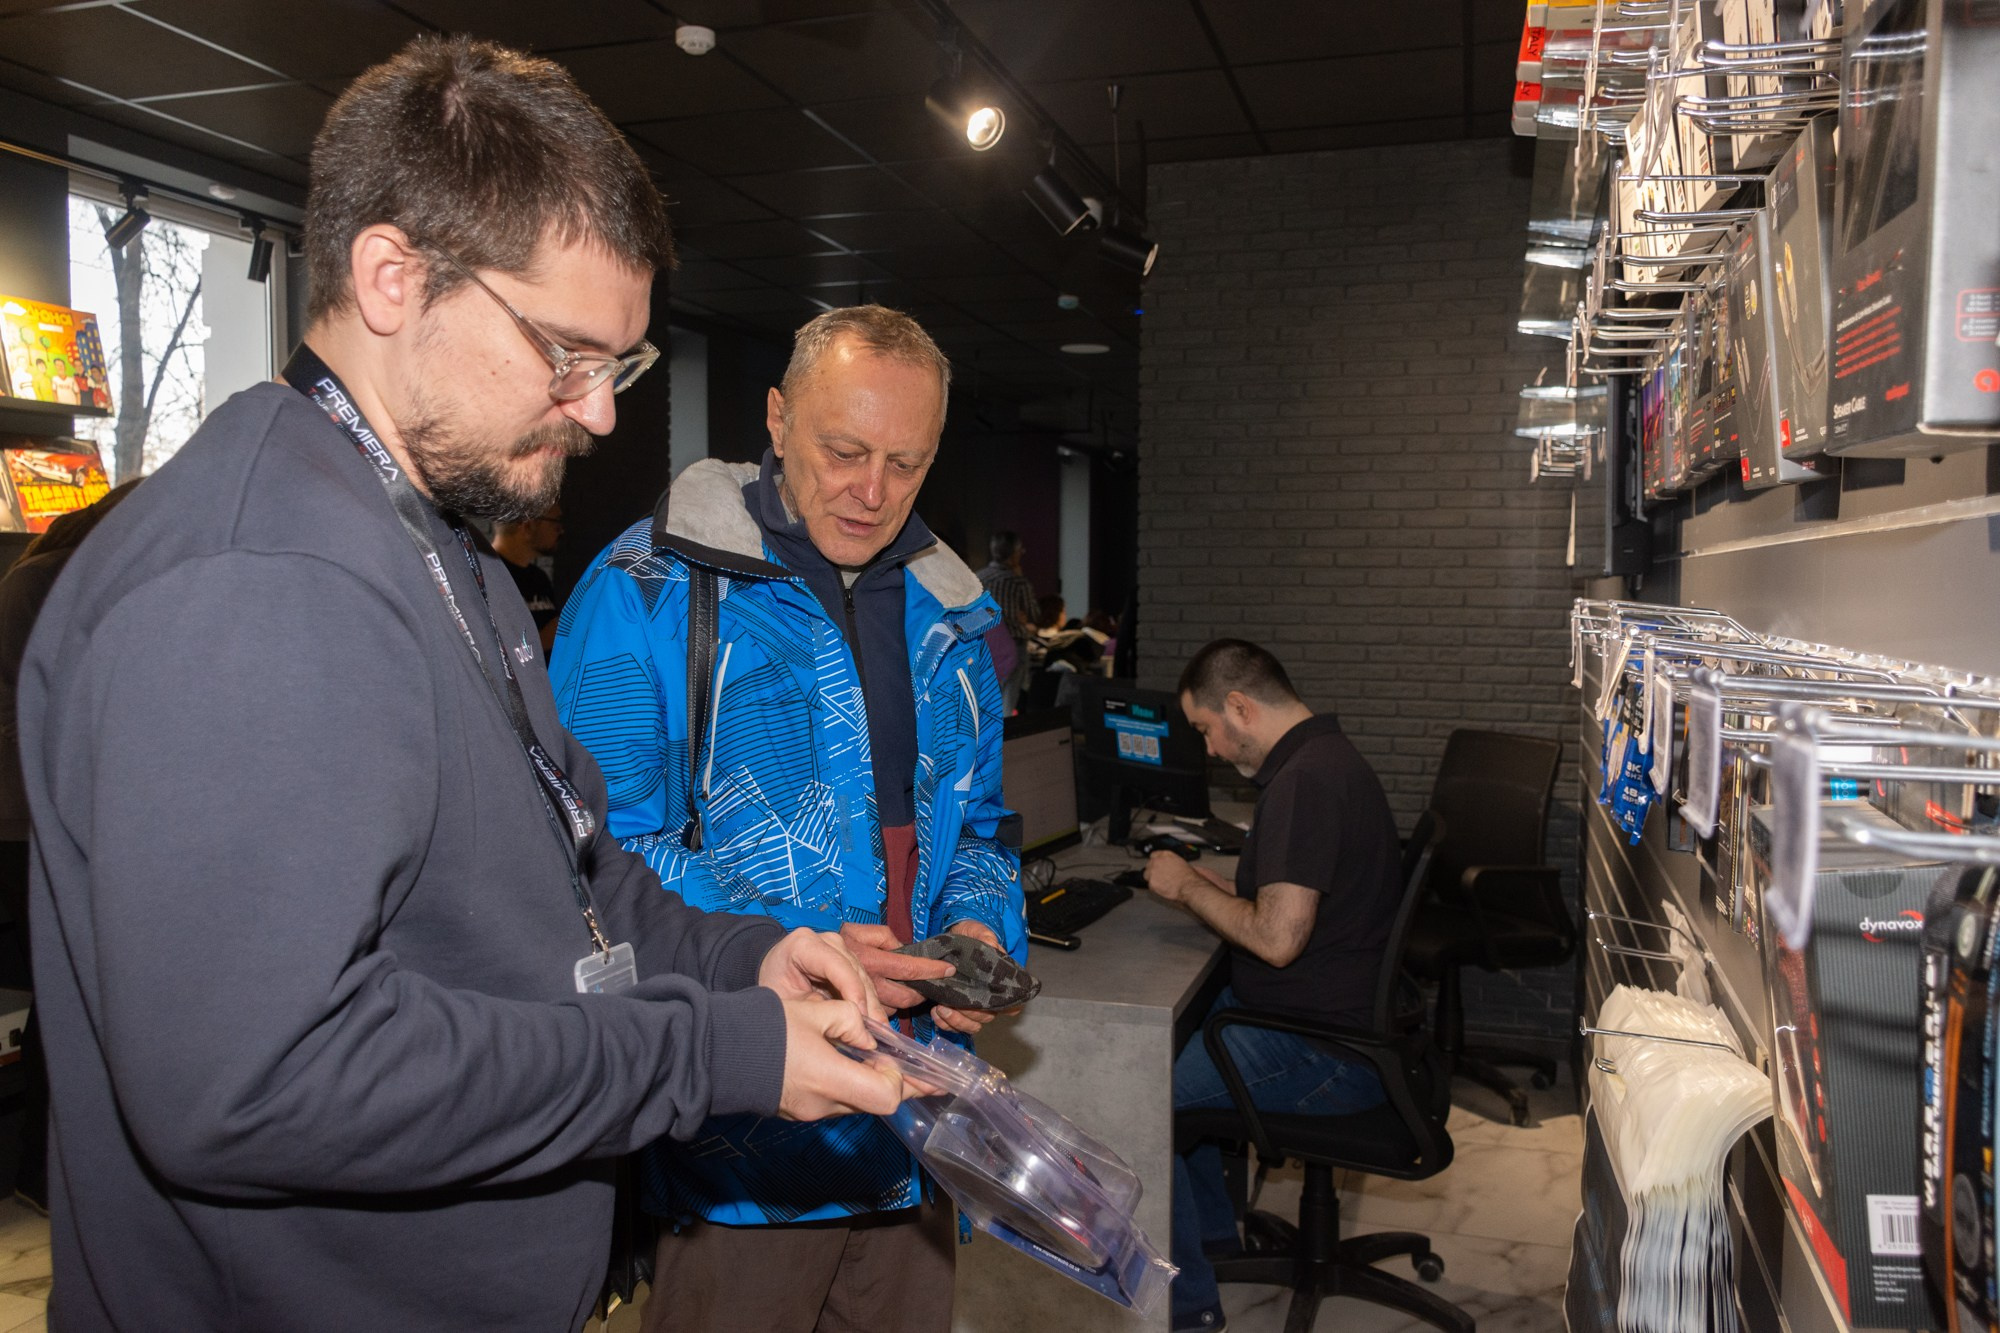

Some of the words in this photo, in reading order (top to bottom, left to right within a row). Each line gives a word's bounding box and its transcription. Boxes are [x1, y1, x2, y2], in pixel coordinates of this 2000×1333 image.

[1528, 28, 1541, 56] TALY
[316, 377, 399, 482] PREMIERA
[529, 745, 588, 838] PREMIERA
[1859, 916, 1923, 934] dynavox
